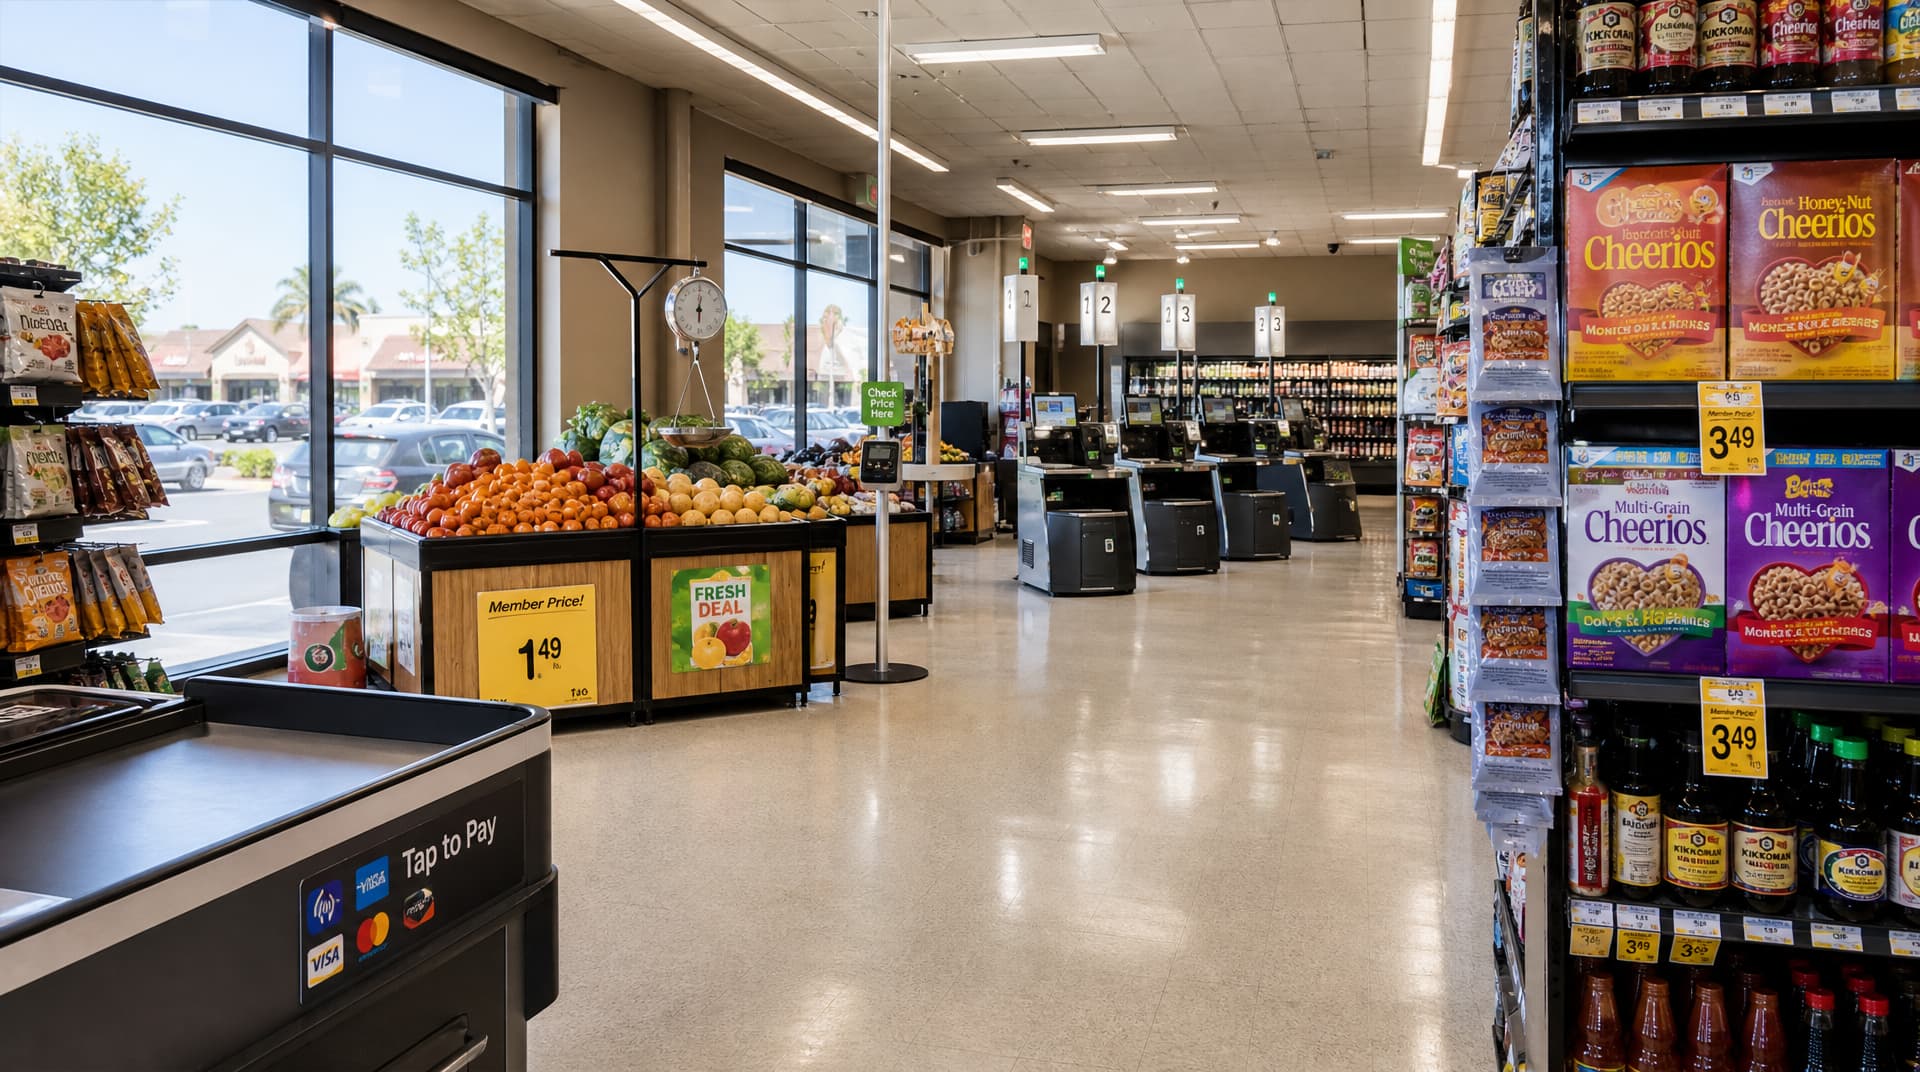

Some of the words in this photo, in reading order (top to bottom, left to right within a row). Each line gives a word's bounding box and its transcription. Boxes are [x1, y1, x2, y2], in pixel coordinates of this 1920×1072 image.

[1798, 195, 1872, 212] Honey-Nut
[1758, 207, 1876, 240] Cheerios
[1584, 235, 1716, 271] Cheerios
[1101, 296, 1111, 313] 2
[1182, 306, 1190, 322] 3
[868, 388, 897, 397] Check
[871, 399, 894, 408] Price
[871, 410, 893, 418] Here
[1615, 500, 1690, 515] Multi-Grain
[1775, 503, 1854, 518] Multi-Grain
[1585, 510, 1706, 545] Cheerios
[1745, 512, 1871, 549] Cheerios
[695, 584, 746, 601] FRESH
[489, 599, 544, 613] Member
[547, 594, 584, 608] Price!
[698, 600, 743, 617] DEAL
[402, 845, 437, 878] Tap
[443, 833, 461, 860] to
[466, 816, 496, 849] Pay
[311, 946, 339, 972] VISA
